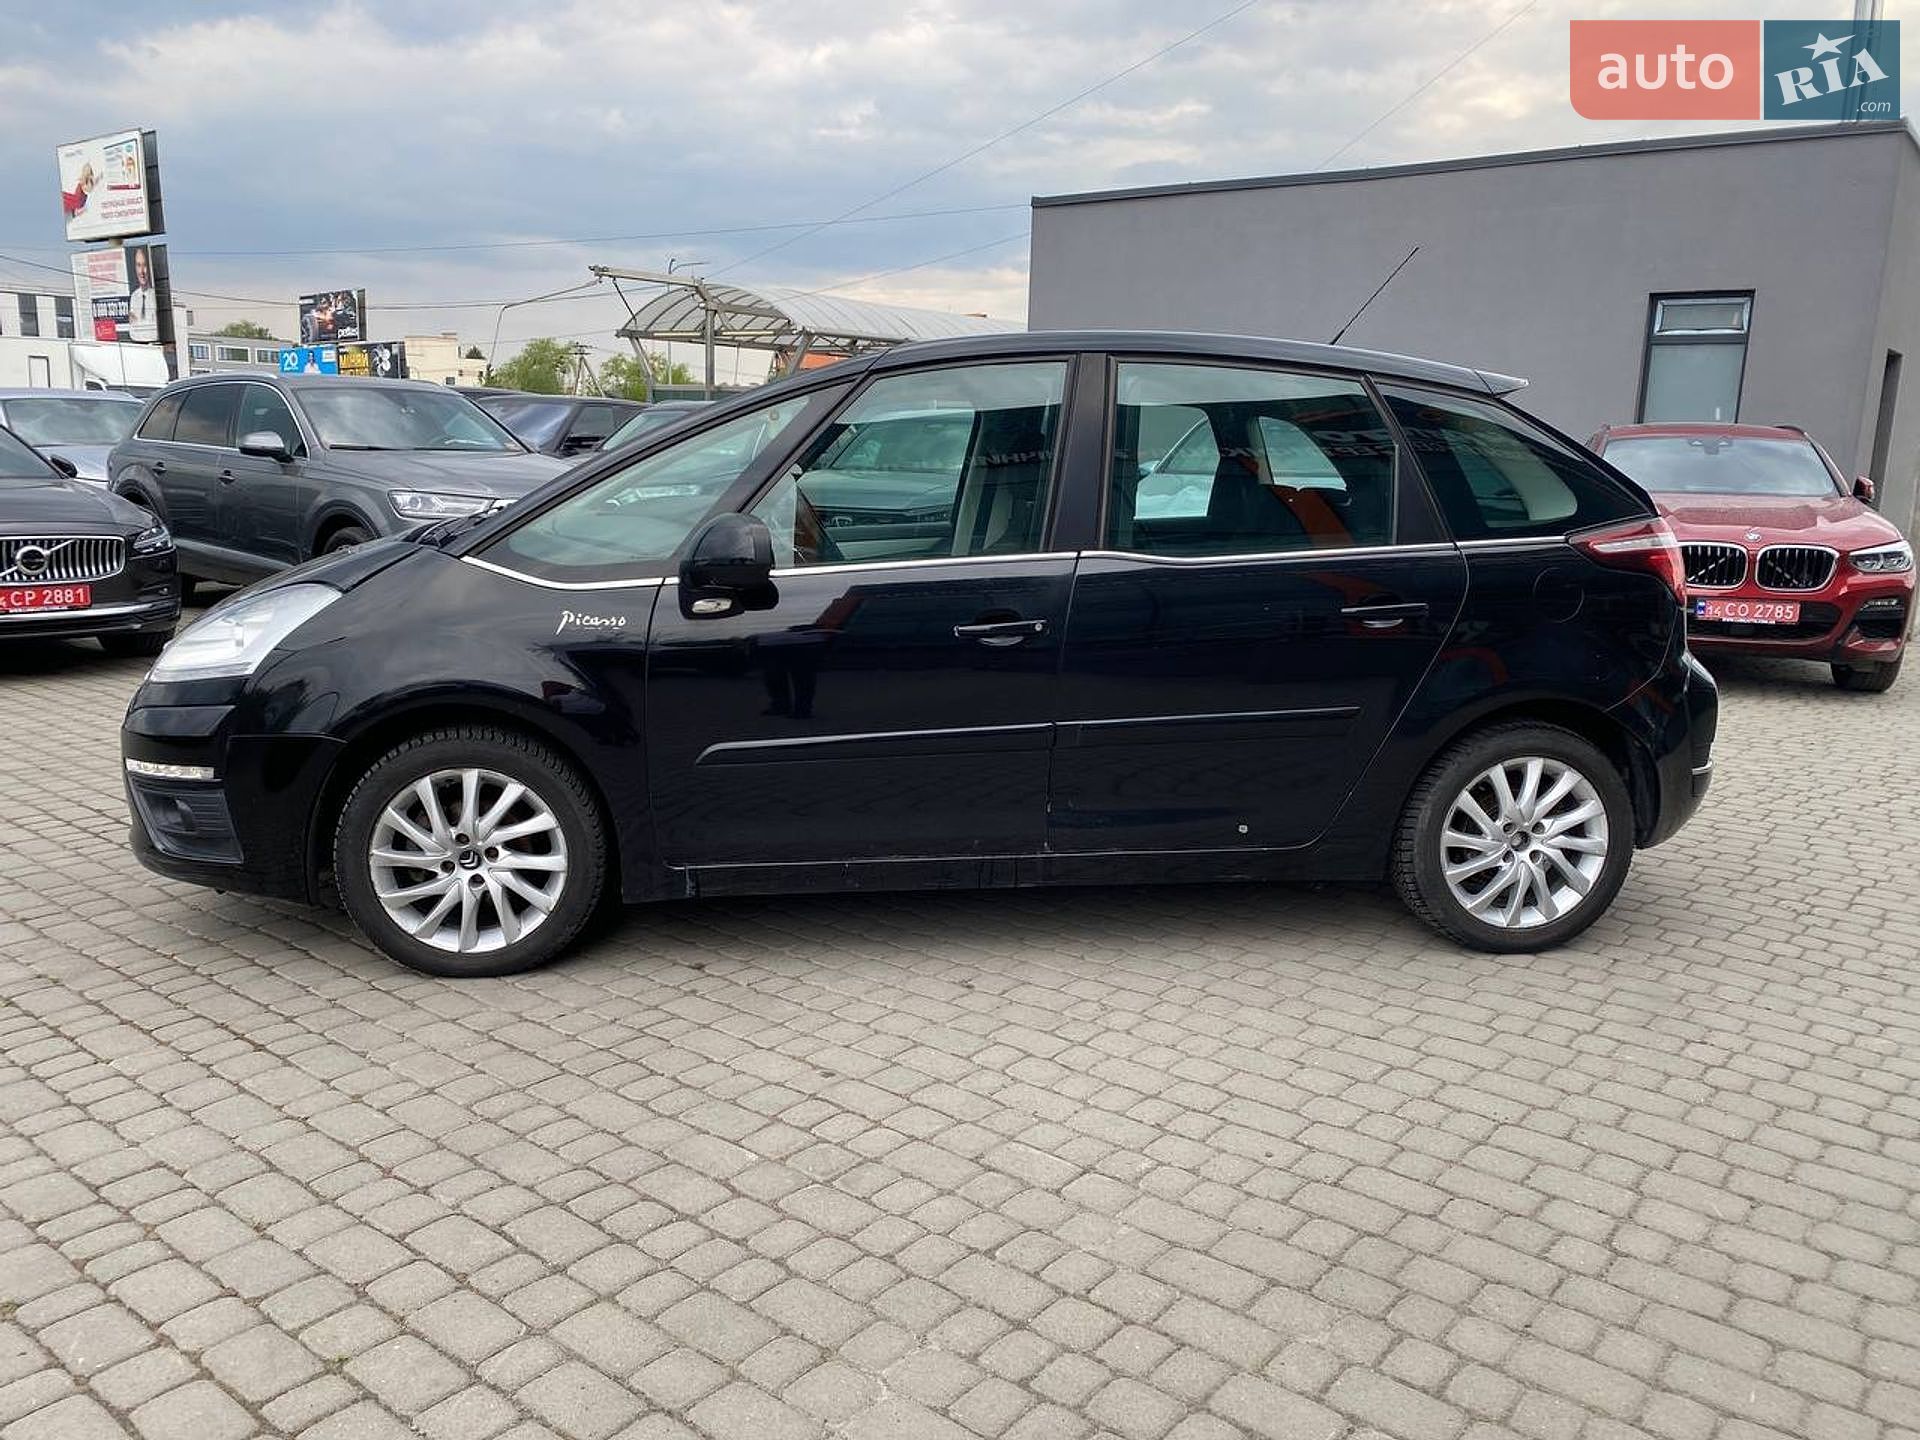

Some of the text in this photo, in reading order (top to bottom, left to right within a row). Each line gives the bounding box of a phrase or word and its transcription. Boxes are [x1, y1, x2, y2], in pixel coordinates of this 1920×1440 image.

[283, 351, 299, 367] 20
[10, 590, 37, 606] CP
[42, 587, 85, 605] 2881
[1725, 602, 1750, 617] CO
[1754, 604, 1794, 620] 2785
